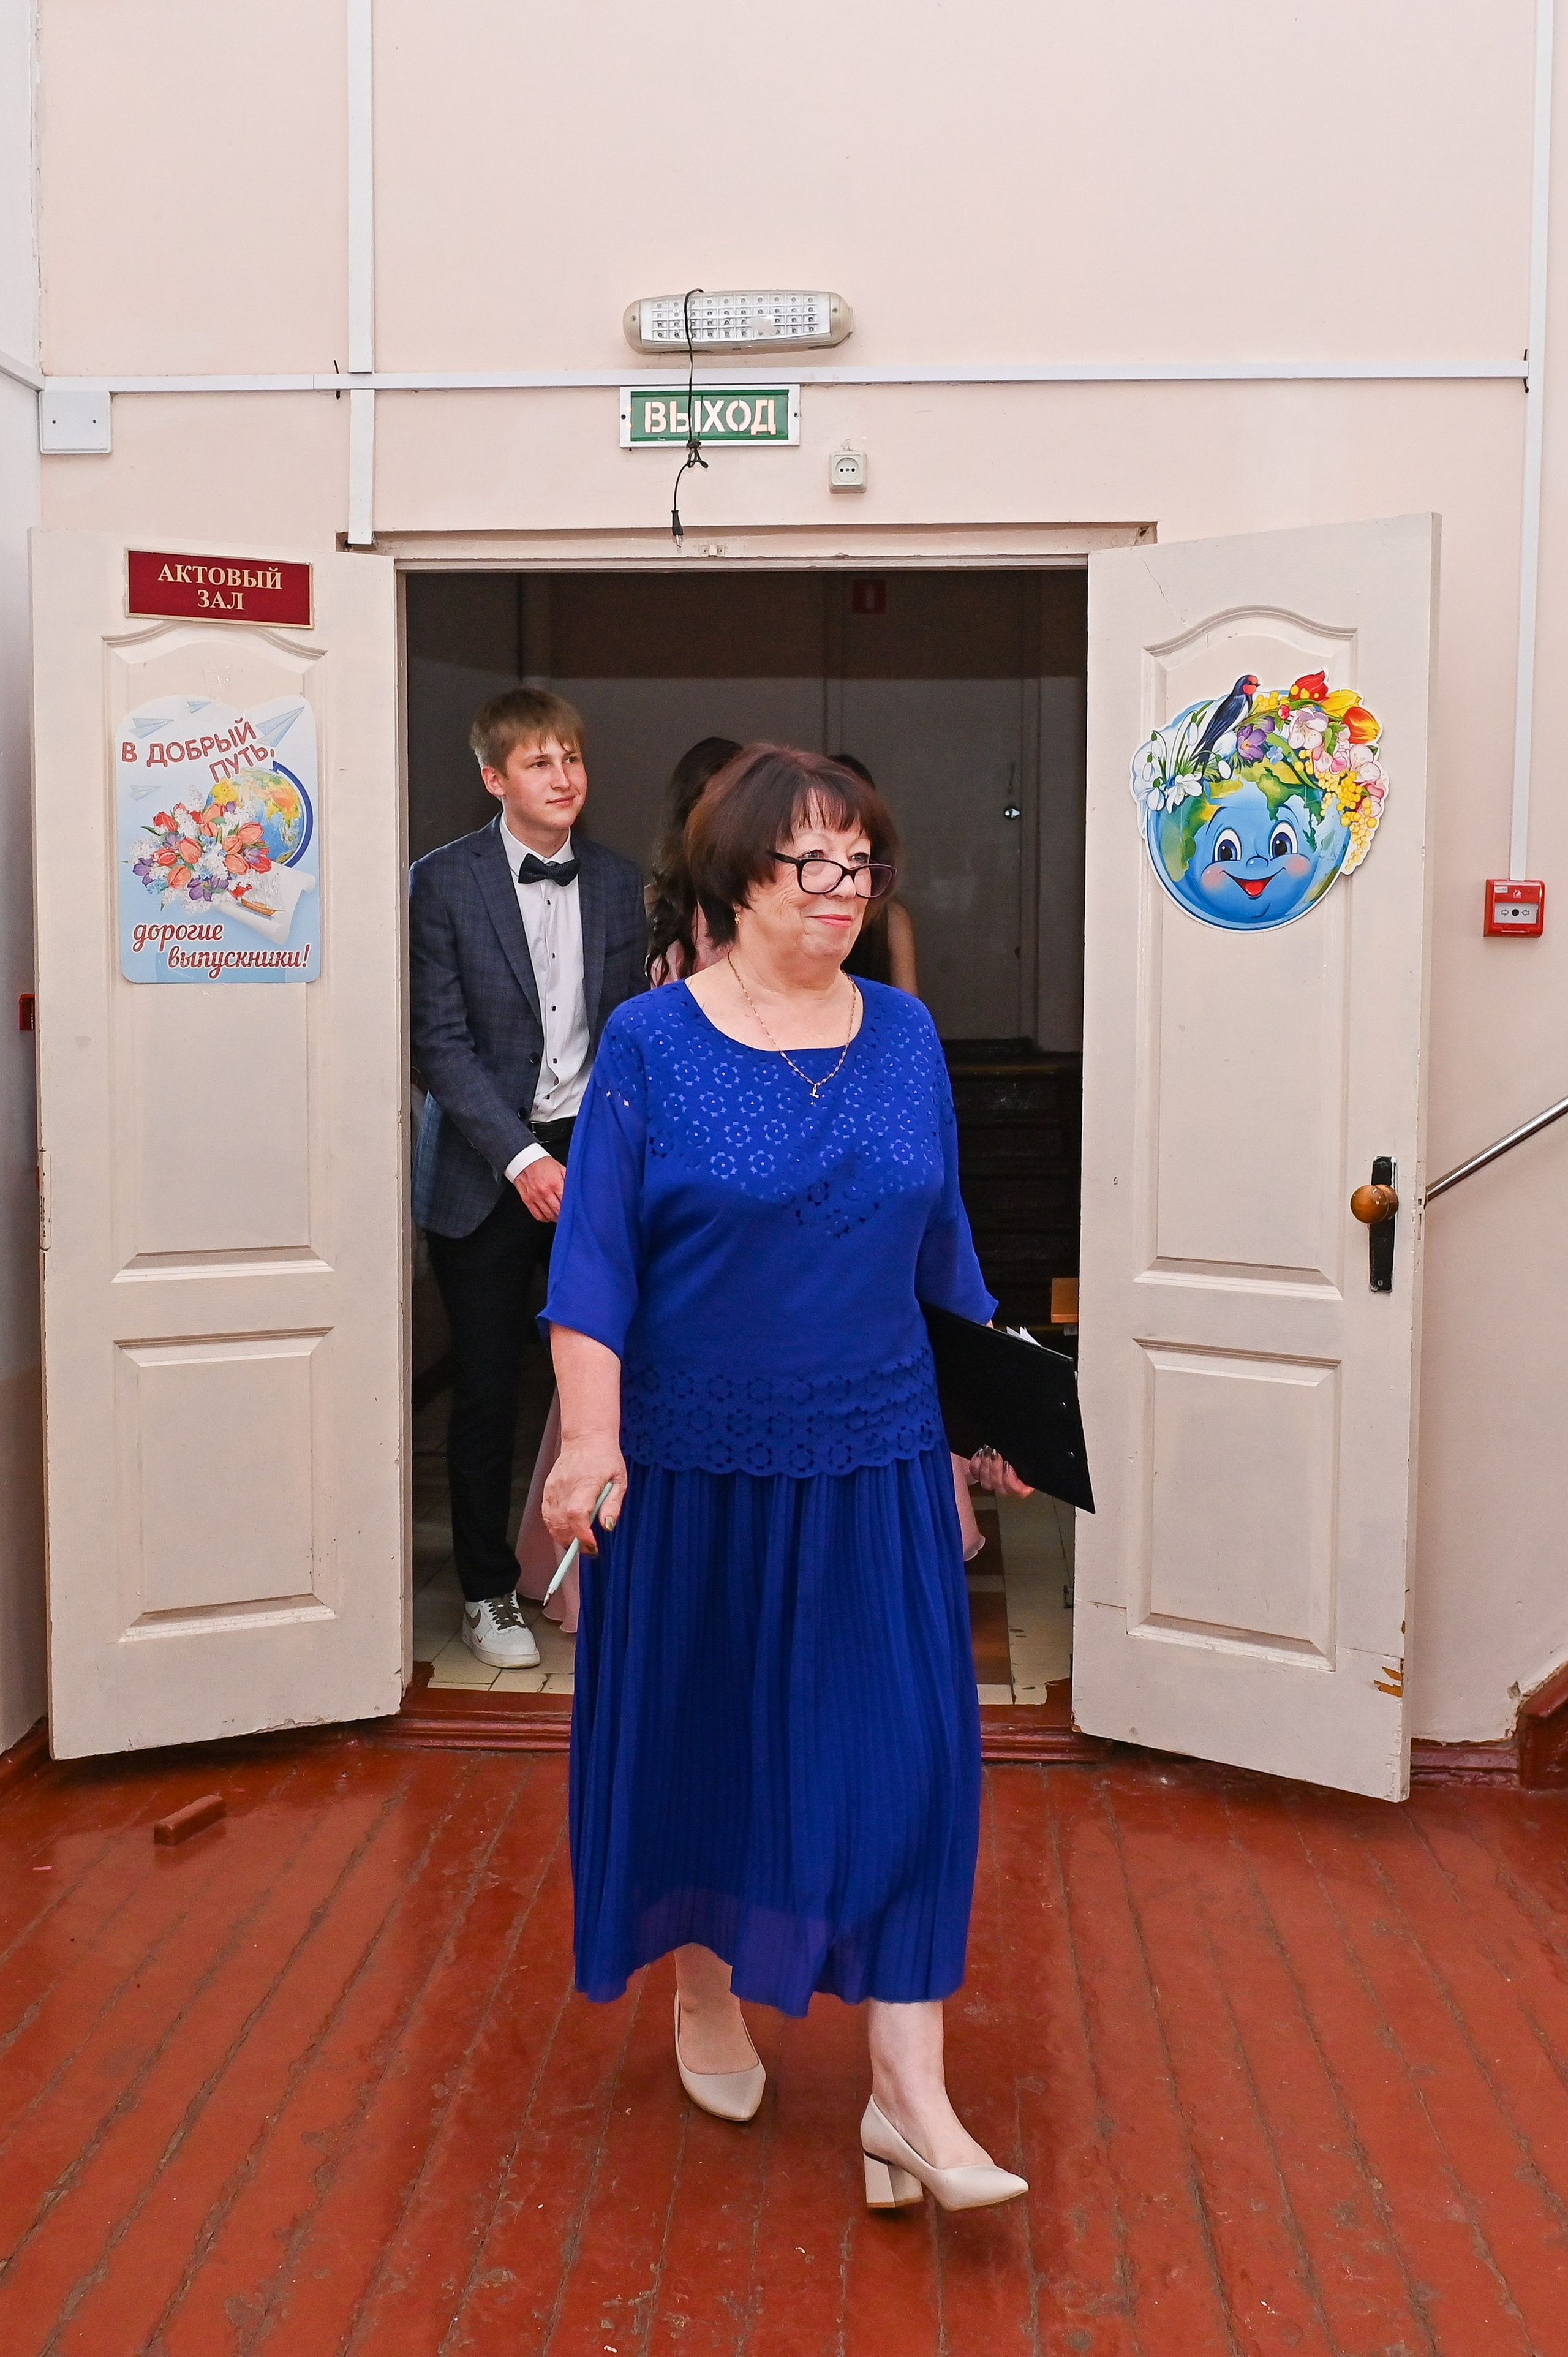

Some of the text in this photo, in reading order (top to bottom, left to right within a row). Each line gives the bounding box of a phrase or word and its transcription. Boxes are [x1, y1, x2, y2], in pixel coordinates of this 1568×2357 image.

[644, 399, 777, 436] ВЫХОД
[157, 563, 283, 590] АКТОВЫЙ
[197, 589, 245, 611] ЗАЛ
[122, 717, 257, 767] В ДОБРЫЙ
[132, 924, 223, 952] дорогие
[168, 943, 311, 979] выпускники!
